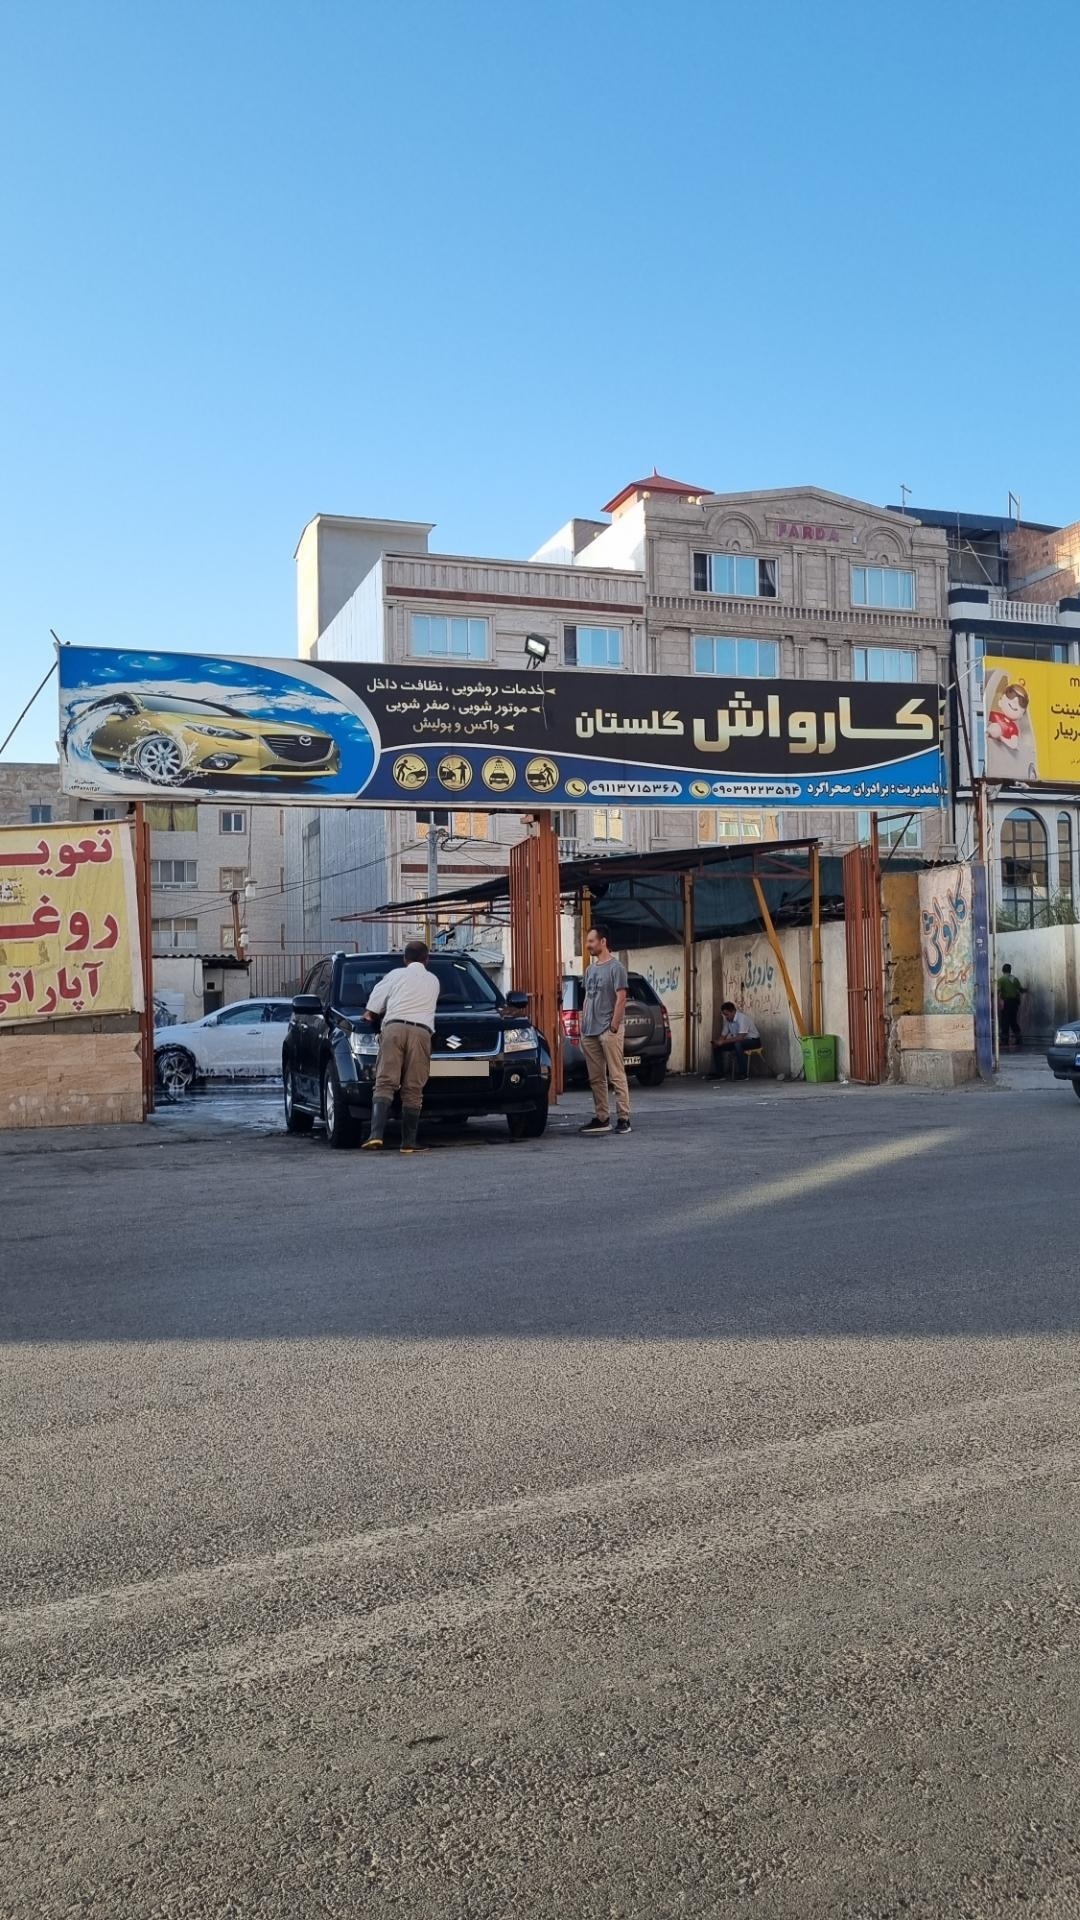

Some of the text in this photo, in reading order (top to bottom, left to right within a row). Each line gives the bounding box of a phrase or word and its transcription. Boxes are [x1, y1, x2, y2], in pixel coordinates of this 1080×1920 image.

[366, 677, 398, 693] داخل
[400, 680, 443, 693] نظافت
[501, 682, 545, 696] خدمات
[385, 698, 420, 713] شویی
[422, 700, 450, 714] صفر
[494, 704, 528, 717] موتور
[412, 716, 500, 735] واکس و پولیش
[575, 691, 934, 754] کارواش گلستان
[591, 783, 679, 794] ۰۹۱۱۳۷۱۵۳۶۸
[712, 785, 800, 795] ۰۹۰۳۹۲۲۳۵۹۴
[807, 781, 851, 797] صحراگرد
[853, 782, 889, 797] برادران
[0, 829, 113, 877] تعوی
[0, 895, 119, 951] روغ
